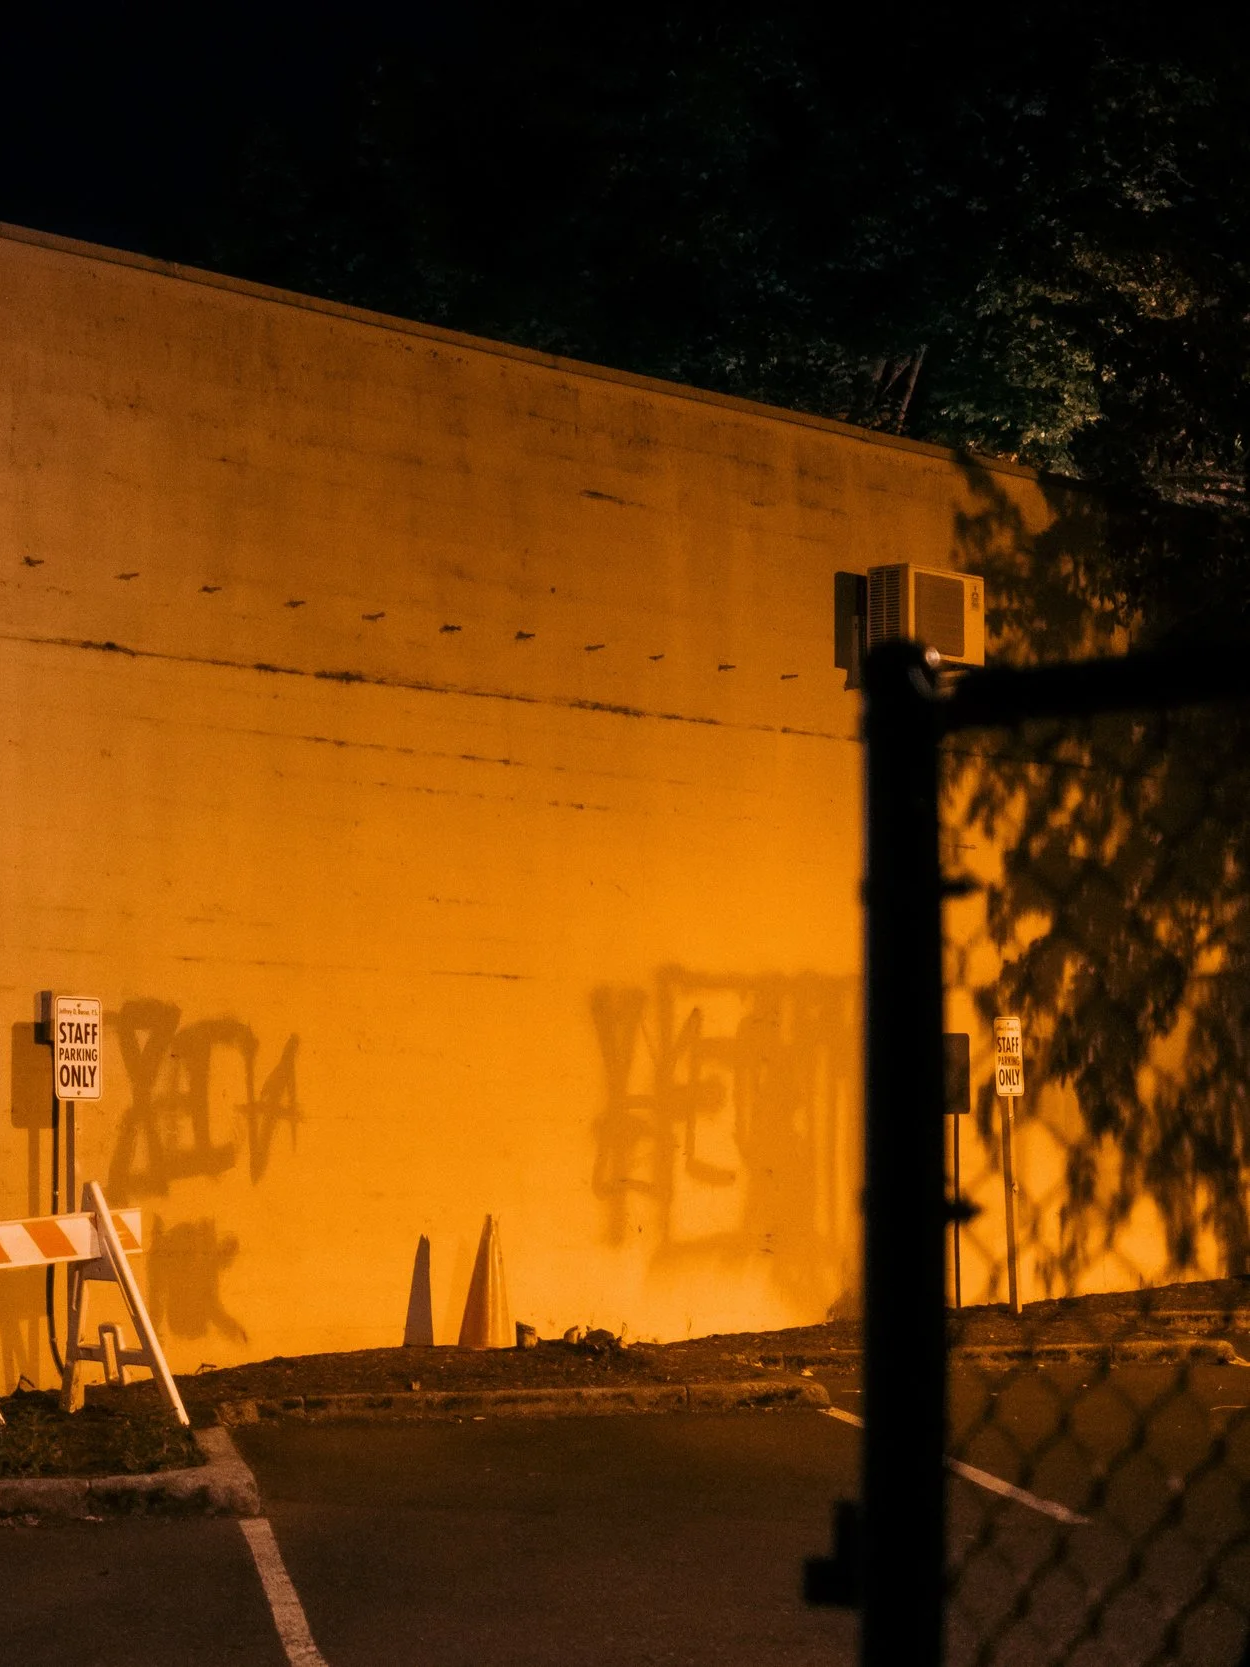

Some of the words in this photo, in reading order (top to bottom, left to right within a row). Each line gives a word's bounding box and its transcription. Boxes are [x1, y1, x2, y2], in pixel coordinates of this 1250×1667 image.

[59, 1021, 98, 1045] STAFF
[997, 1036, 1019, 1053] STAFF
[59, 1047, 98, 1062] PARKING
[998, 1056, 1020, 1066] PARKING
[59, 1064, 97, 1088] ONLY
[998, 1069, 1020, 1086] ONLY
